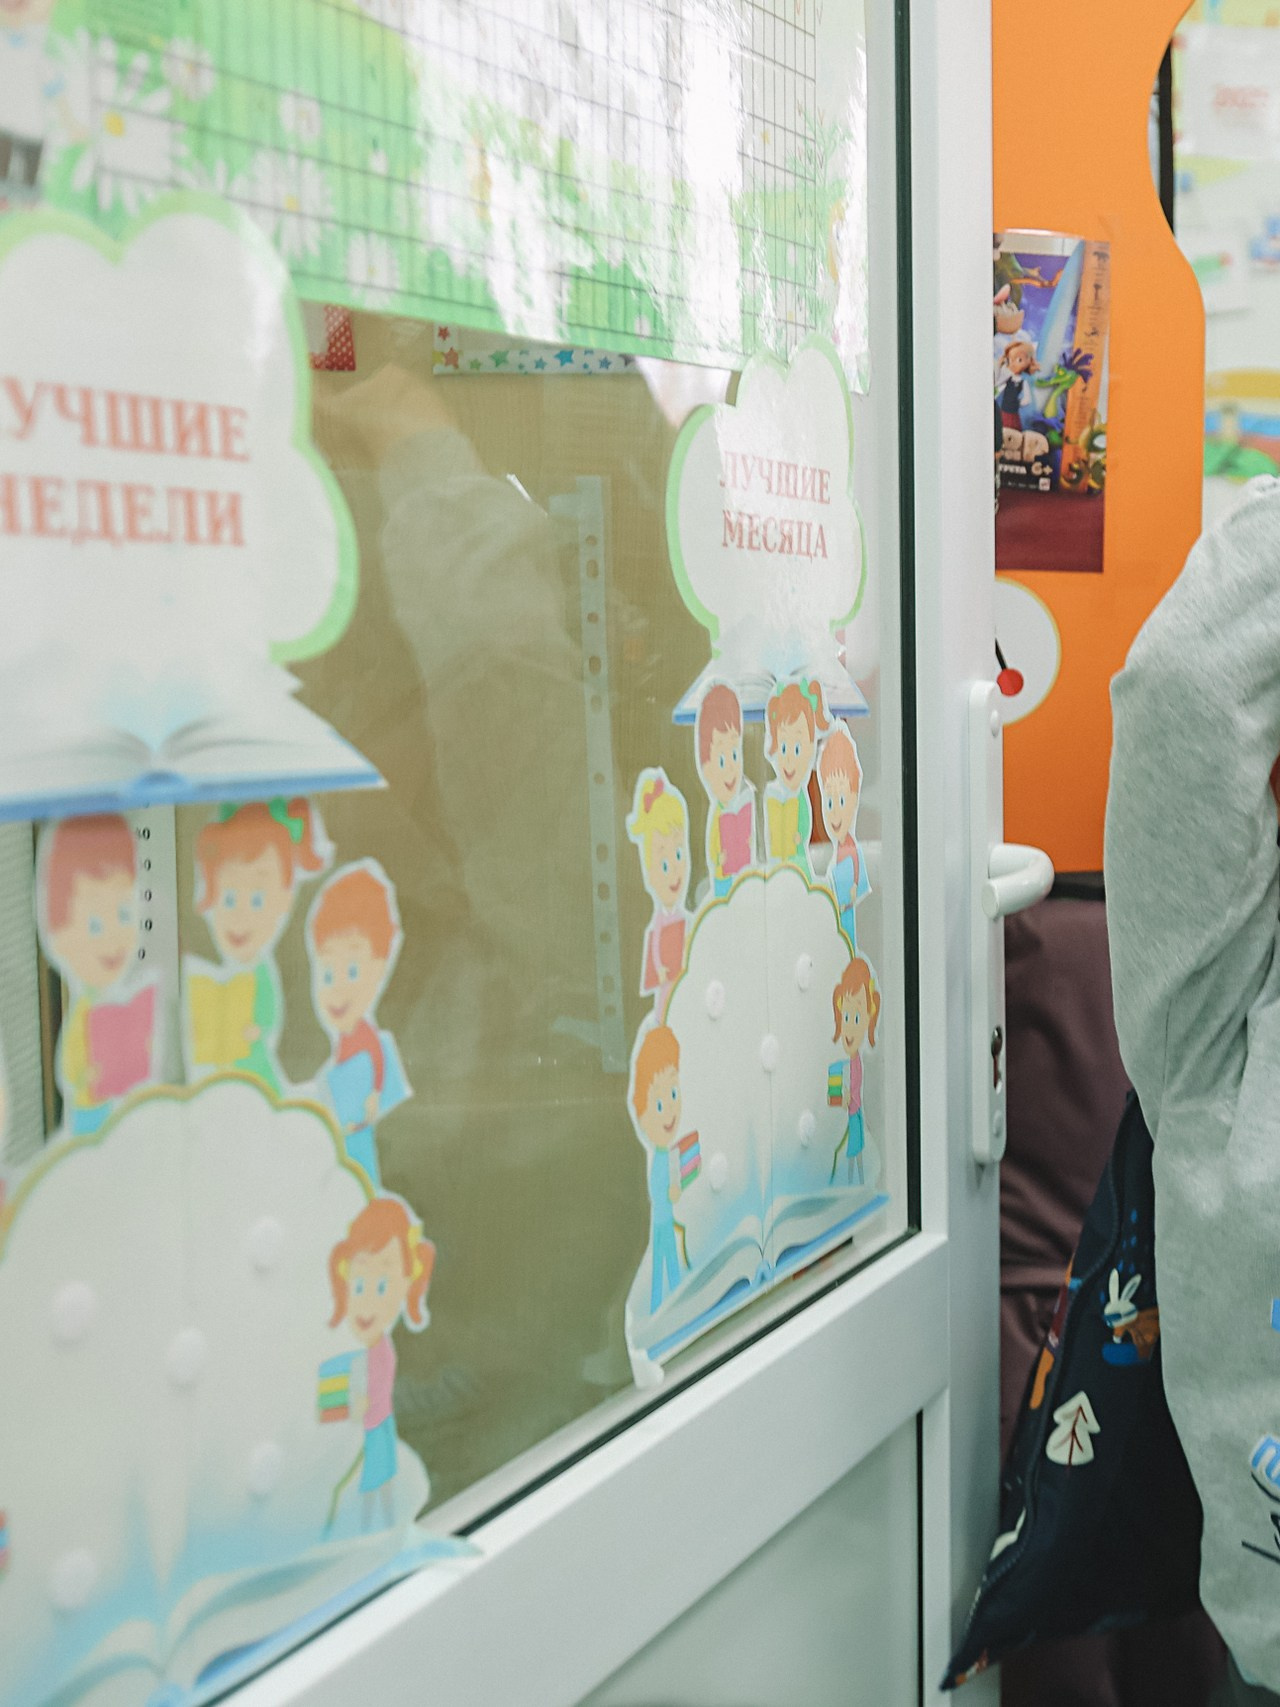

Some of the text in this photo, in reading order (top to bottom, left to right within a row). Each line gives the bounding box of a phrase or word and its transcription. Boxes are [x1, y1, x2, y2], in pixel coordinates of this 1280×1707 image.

[0, 376, 250, 463] УЧШИЕ
[720, 451, 831, 504] ЛУЧШИЕ
[1031, 461, 1053, 476] 6+
[722, 509, 828, 563] МЕСЯЦА
